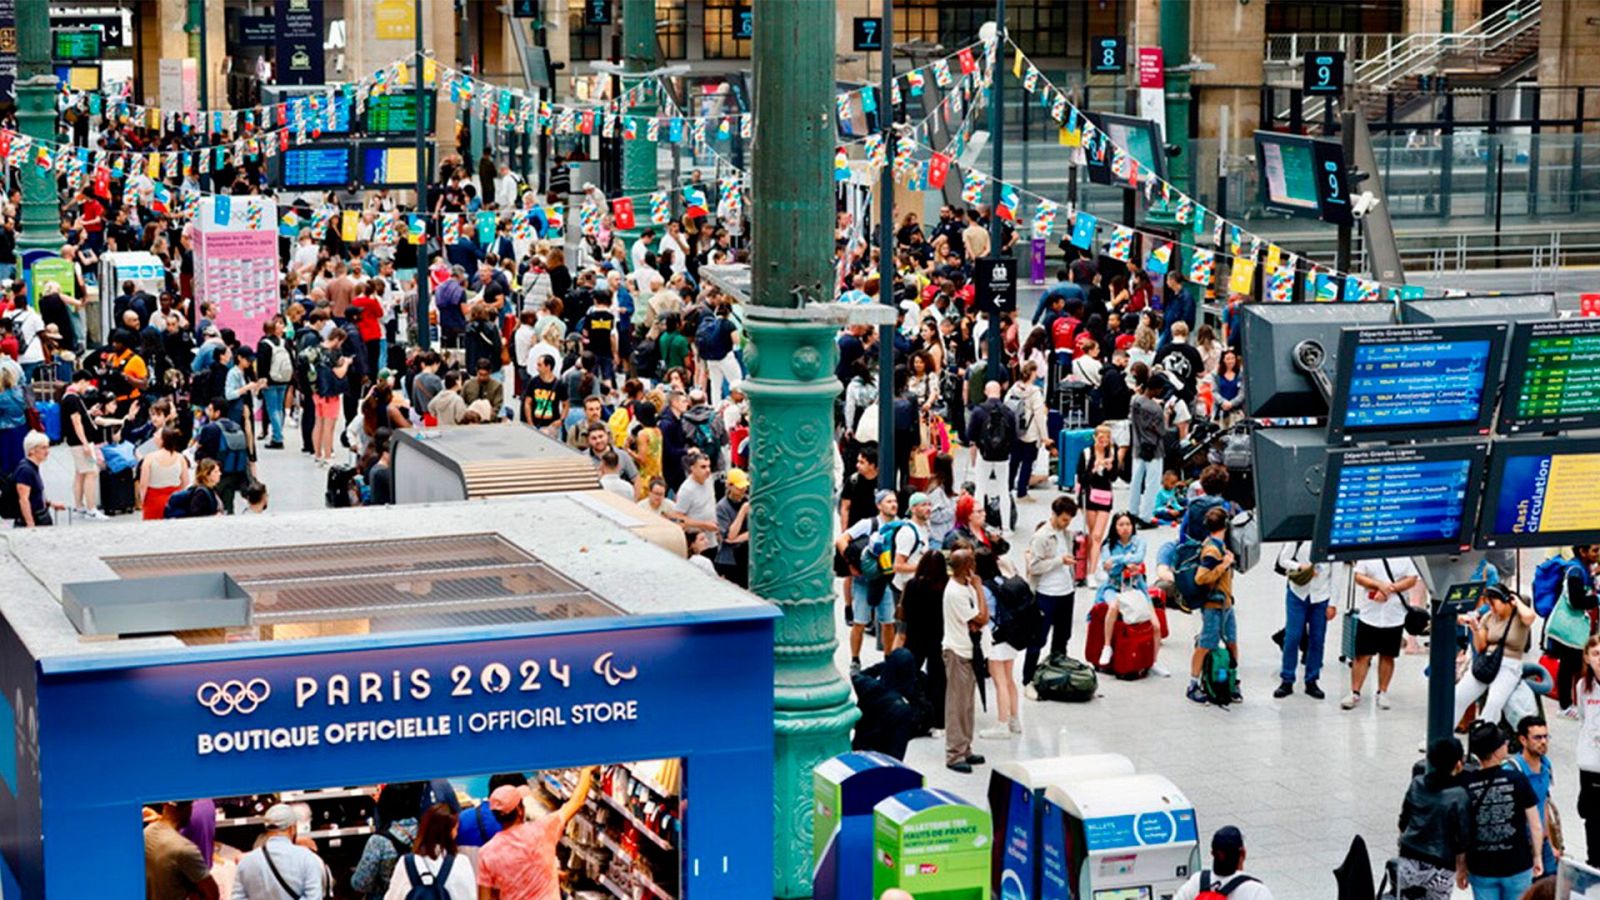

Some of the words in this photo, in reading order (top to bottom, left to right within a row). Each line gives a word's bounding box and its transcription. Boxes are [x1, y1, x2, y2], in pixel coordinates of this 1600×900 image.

[594, 7, 603, 19] 5
[742, 19, 752, 34] 6
[864, 29, 875, 43] 7
[1103, 48, 1115, 66] 8
[1318, 66, 1331, 86] 9
[1328, 174, 1338, 198] 9
[1527, 459, 1550, 533] circulation
[1512, 500, 1530, 533] flash
[450, 658, 571, 698] 2024
[197, 724, 320, 756] BOUTIQUE
[324, 715, 451, 746] OFFICIELLE
[468, 706, 566, 734] OFFICIAL
[570, 700, 639, 725] STORE
